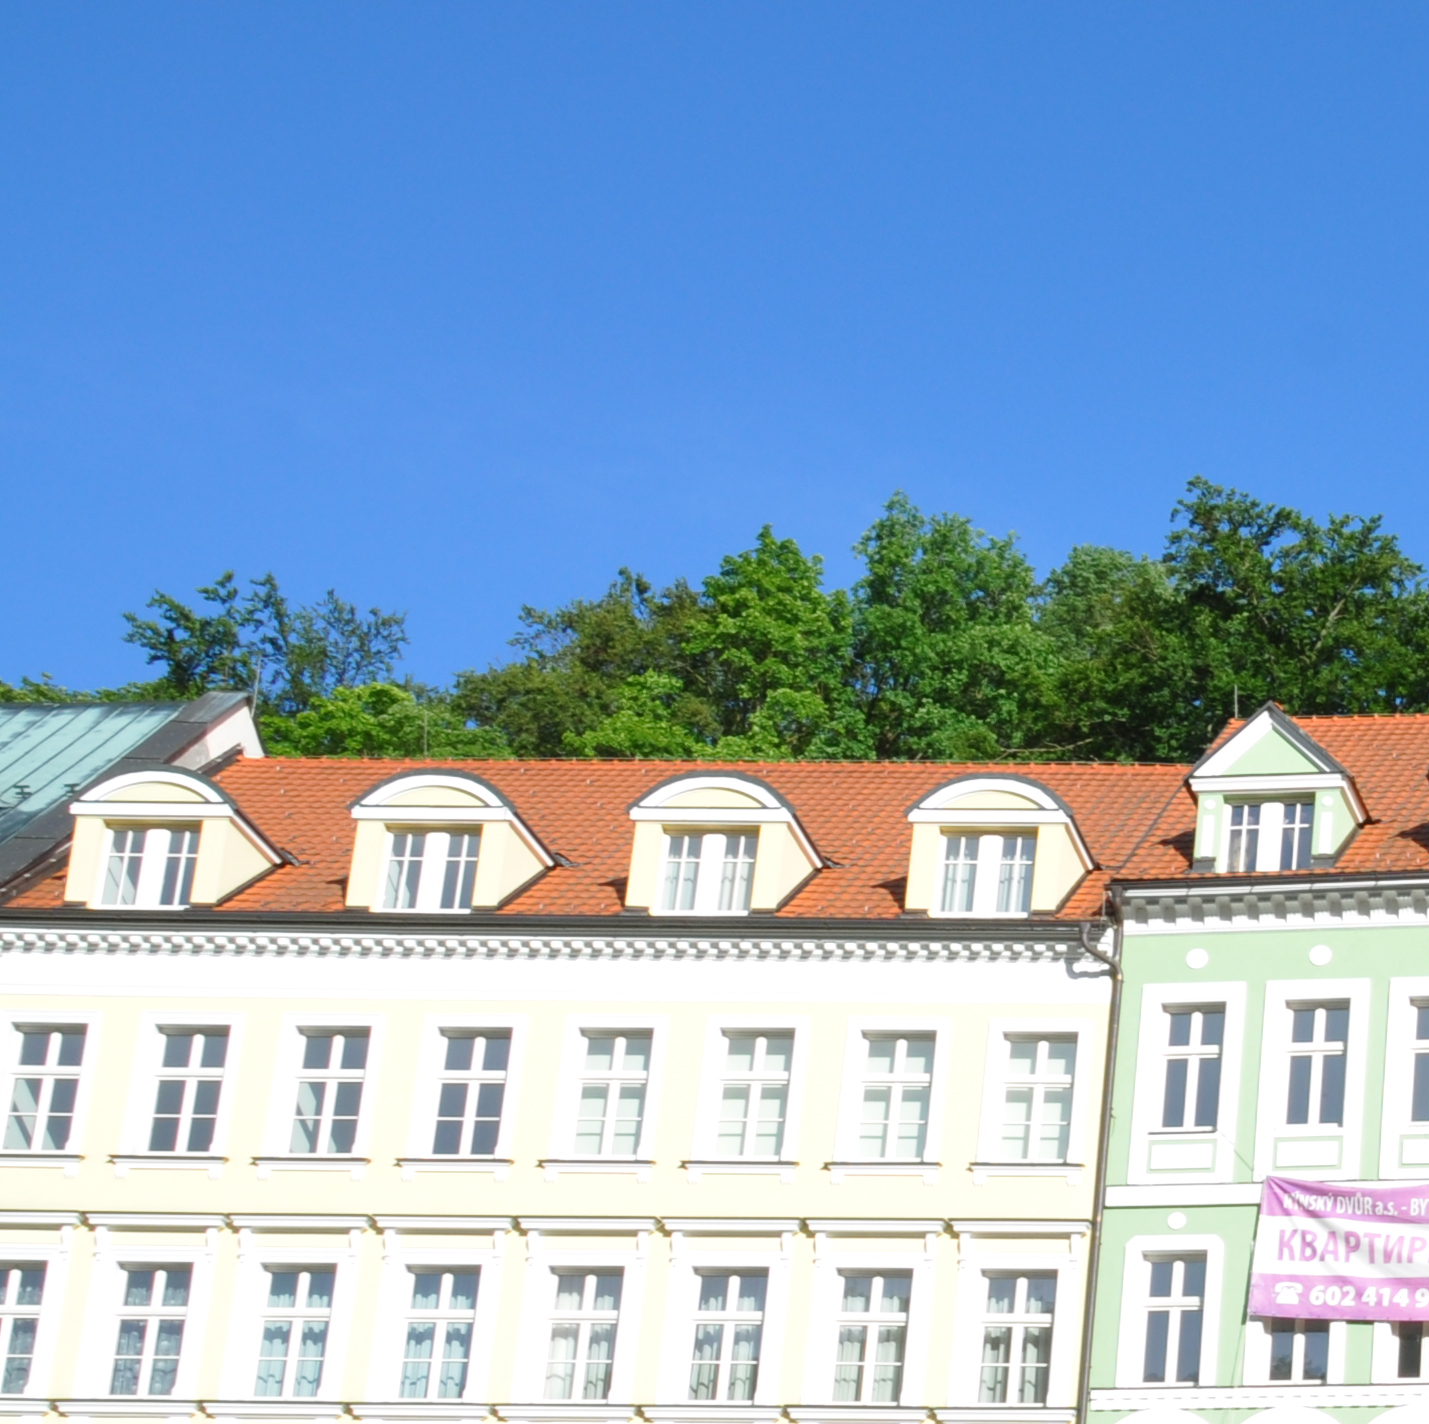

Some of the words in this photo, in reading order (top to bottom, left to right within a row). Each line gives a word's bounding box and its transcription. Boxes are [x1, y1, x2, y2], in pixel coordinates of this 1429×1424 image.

[1336, 1192, 1372, 1215] DVŮR
[1375, 1199, 1398, 1216] a.s.
[1309, 1285, 1355, 1306] 602
[1361, 1286, 1408, 1307] 414
